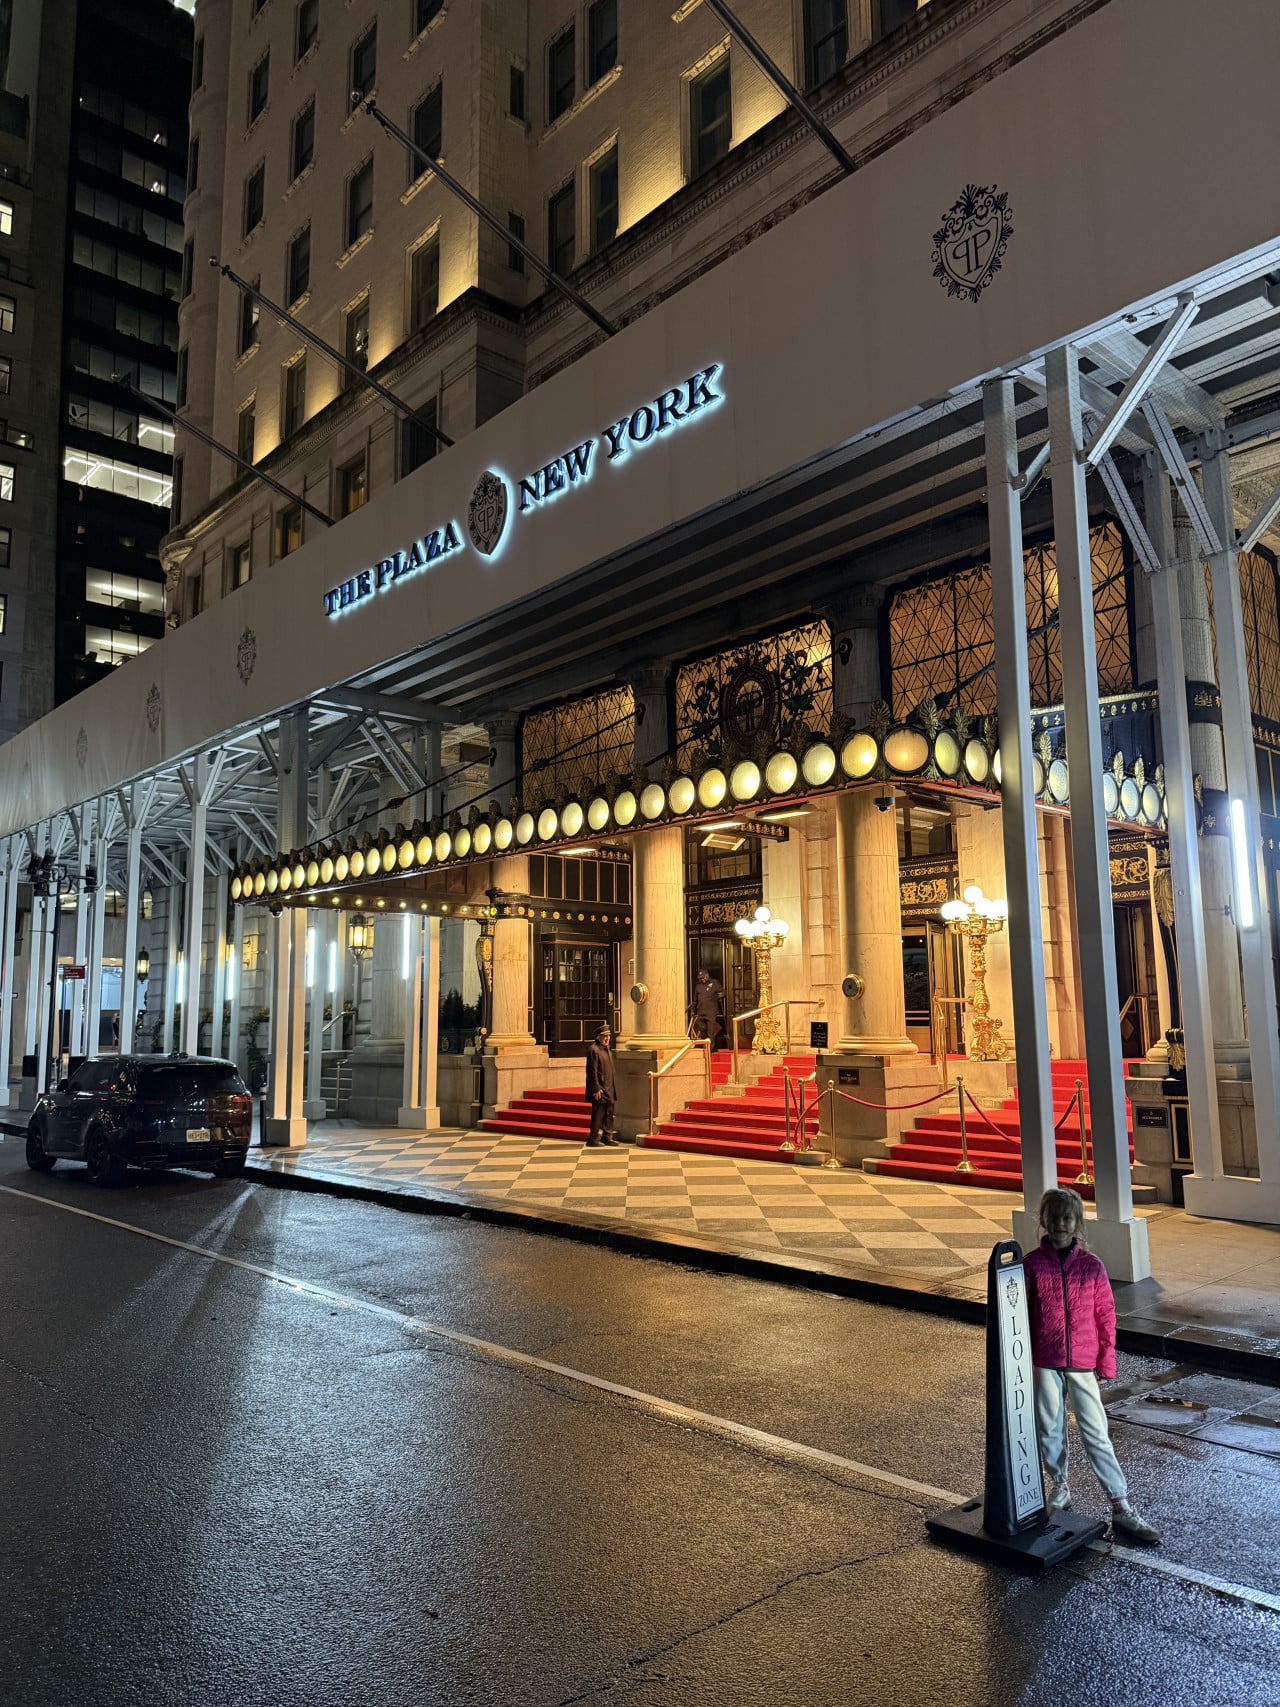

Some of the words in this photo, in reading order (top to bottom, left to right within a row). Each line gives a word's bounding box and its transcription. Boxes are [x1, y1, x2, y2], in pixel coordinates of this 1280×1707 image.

[323, 570, 373, 617] THE
[375, 522, 461, 589] PLAZA
[517, 439, 595, 511] NEW
[601, 364, 721, 459] YORK
[1011, 1315, 1031, 1486] LOADING
[1018, 1487, 1040, 1508] ZONE
